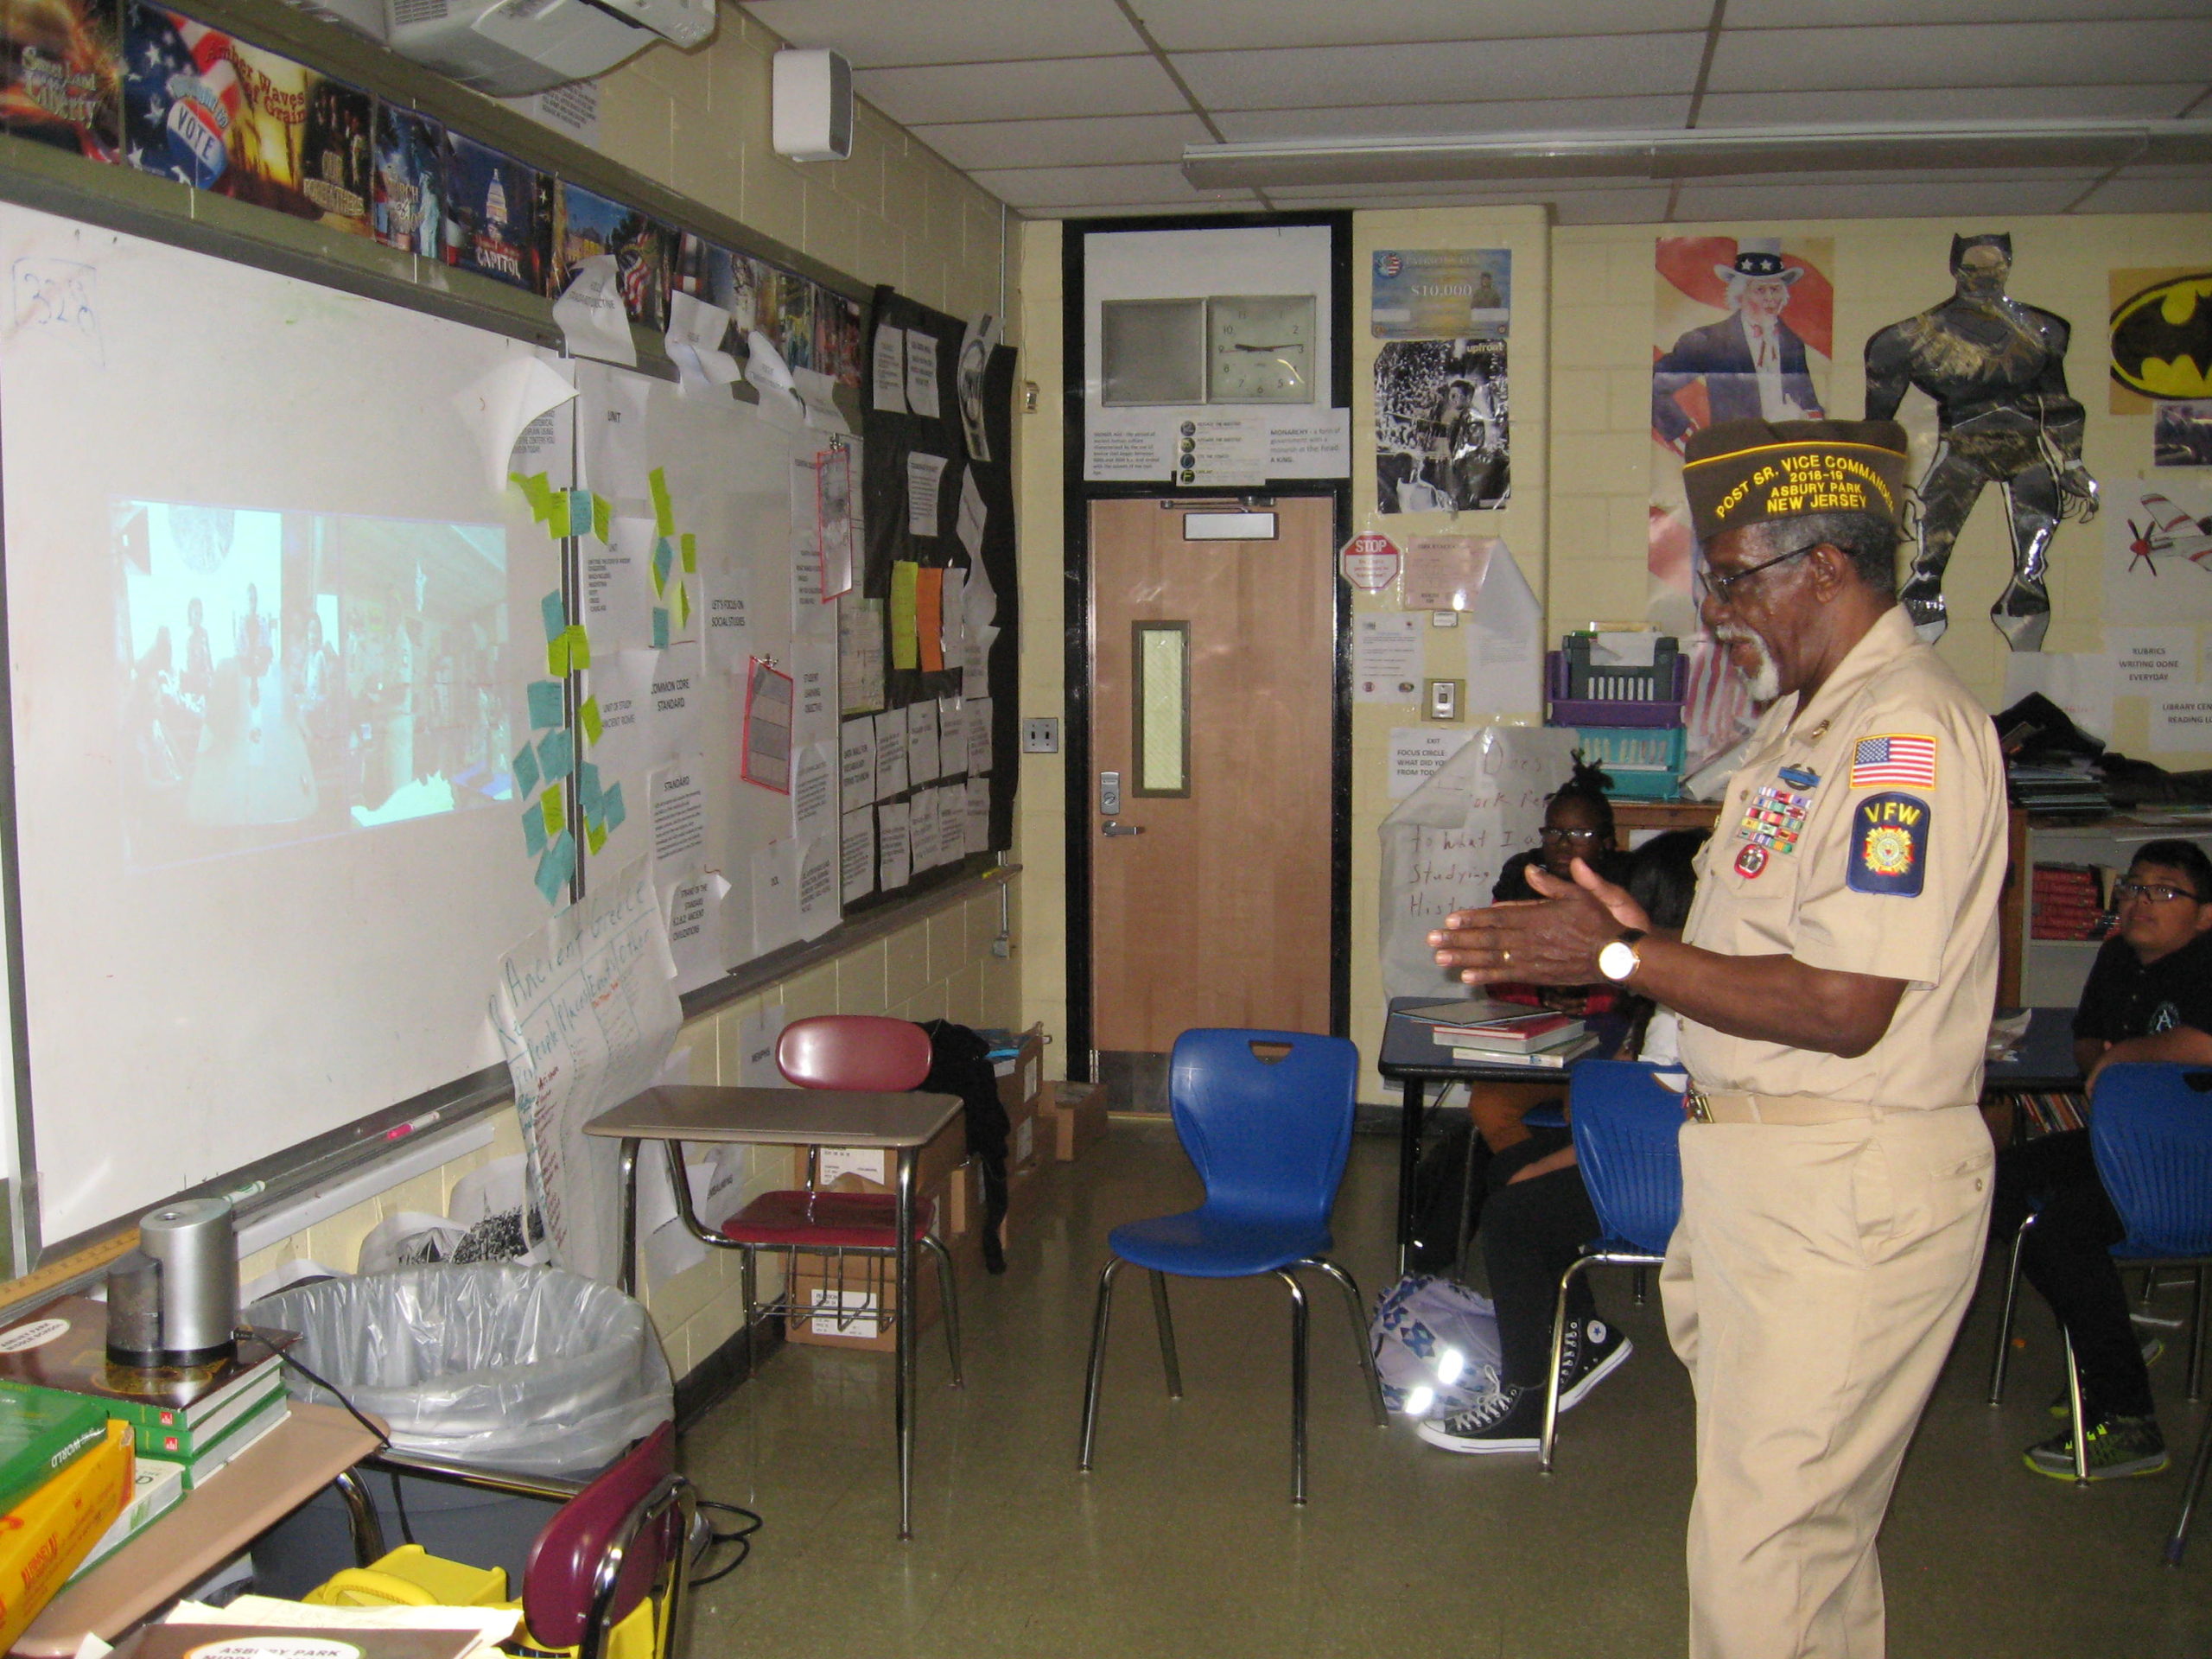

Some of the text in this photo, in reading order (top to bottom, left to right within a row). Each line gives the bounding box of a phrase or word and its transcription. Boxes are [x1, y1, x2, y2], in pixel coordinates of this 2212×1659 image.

[258, 69, 305, 111] Waves
[264, 95, 306, 124] Grain
[178, 106, 215, 161] VOTE
[476, 245, 522, 281] CAPITOL
[1467, 342, 1503, 354] upfront
[1716, 454, 1894, 518] POST SR. VICE COMMANDER
[1771, 482, 1863, 499] ASBURY PARK
[1766, 493, 1867, 512] NEW JERSEY
[1355, 539, 1388, 554] STOP
[2133, 647, 2166, 656] RUBRICS
[651, 678, 690, 695] COMMON CORE
[658, 697, 685, 712] STANDARD
[664, 776, 690, 791] STANDARD
[1864, 801, 1921, 826] VFW
[1444, 830, 1486, 849] what
[1410, 861, 1491, 887] Studying
[505, 930, 583, 1007] Ancient
[591, 880, 646, 939] Greece
[51, 1438, 81, 1468] WORLD
[292, 1649, 342, 1657] PARK
